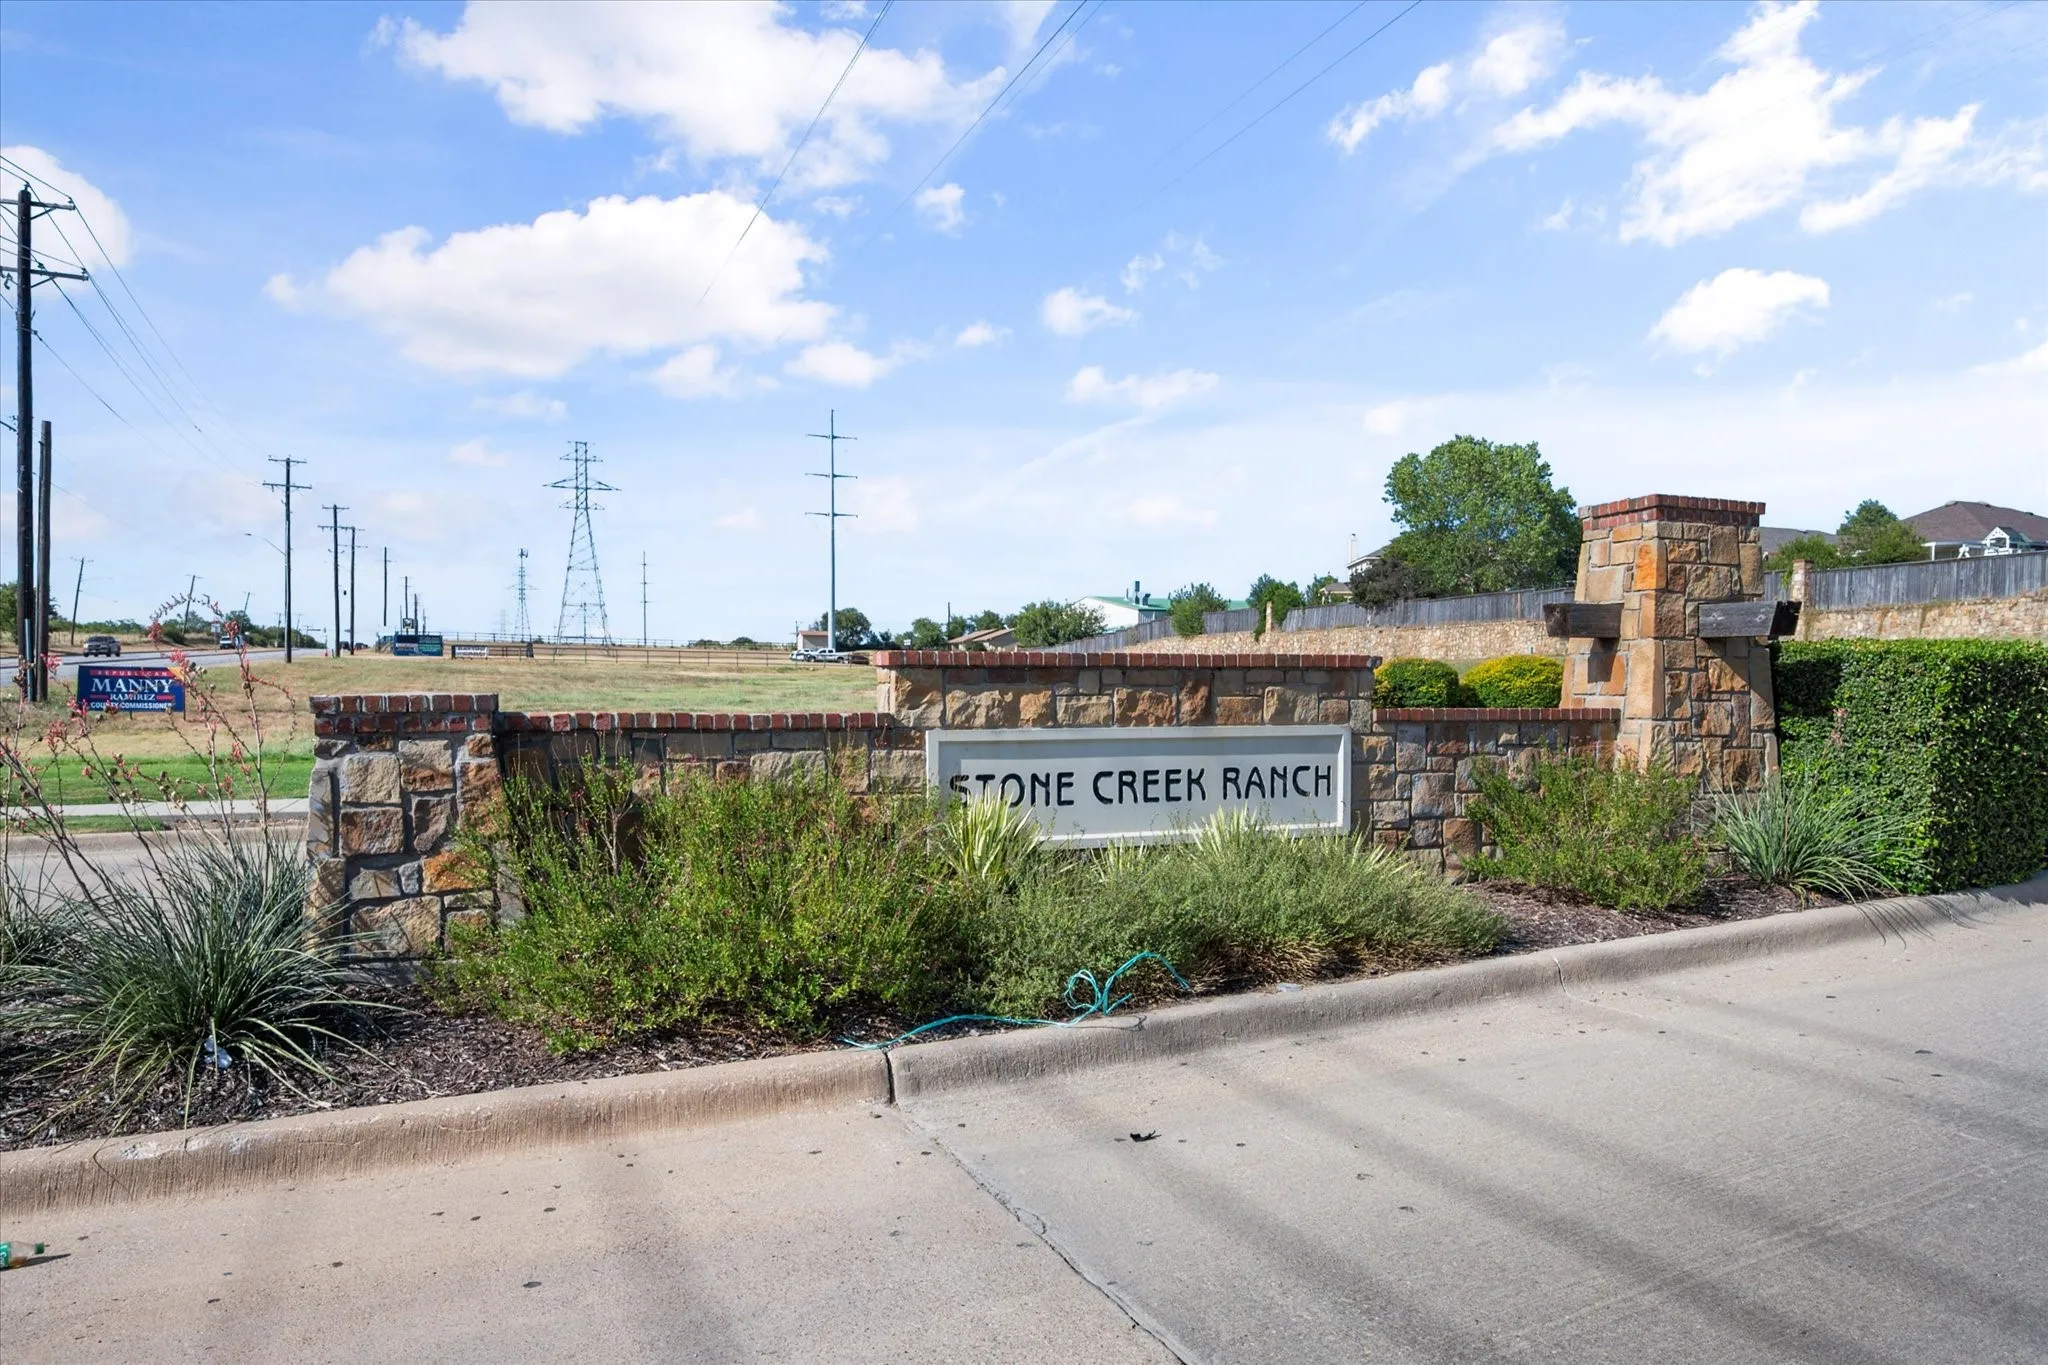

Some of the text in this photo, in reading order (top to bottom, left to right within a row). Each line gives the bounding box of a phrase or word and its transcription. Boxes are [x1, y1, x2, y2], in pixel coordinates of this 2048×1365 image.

[91, 678, 173, 693] MANNY
[110, 693, 156, 701] RAMIREZ
[949, 765, 1332, 808] STONE CREEK RANCH
